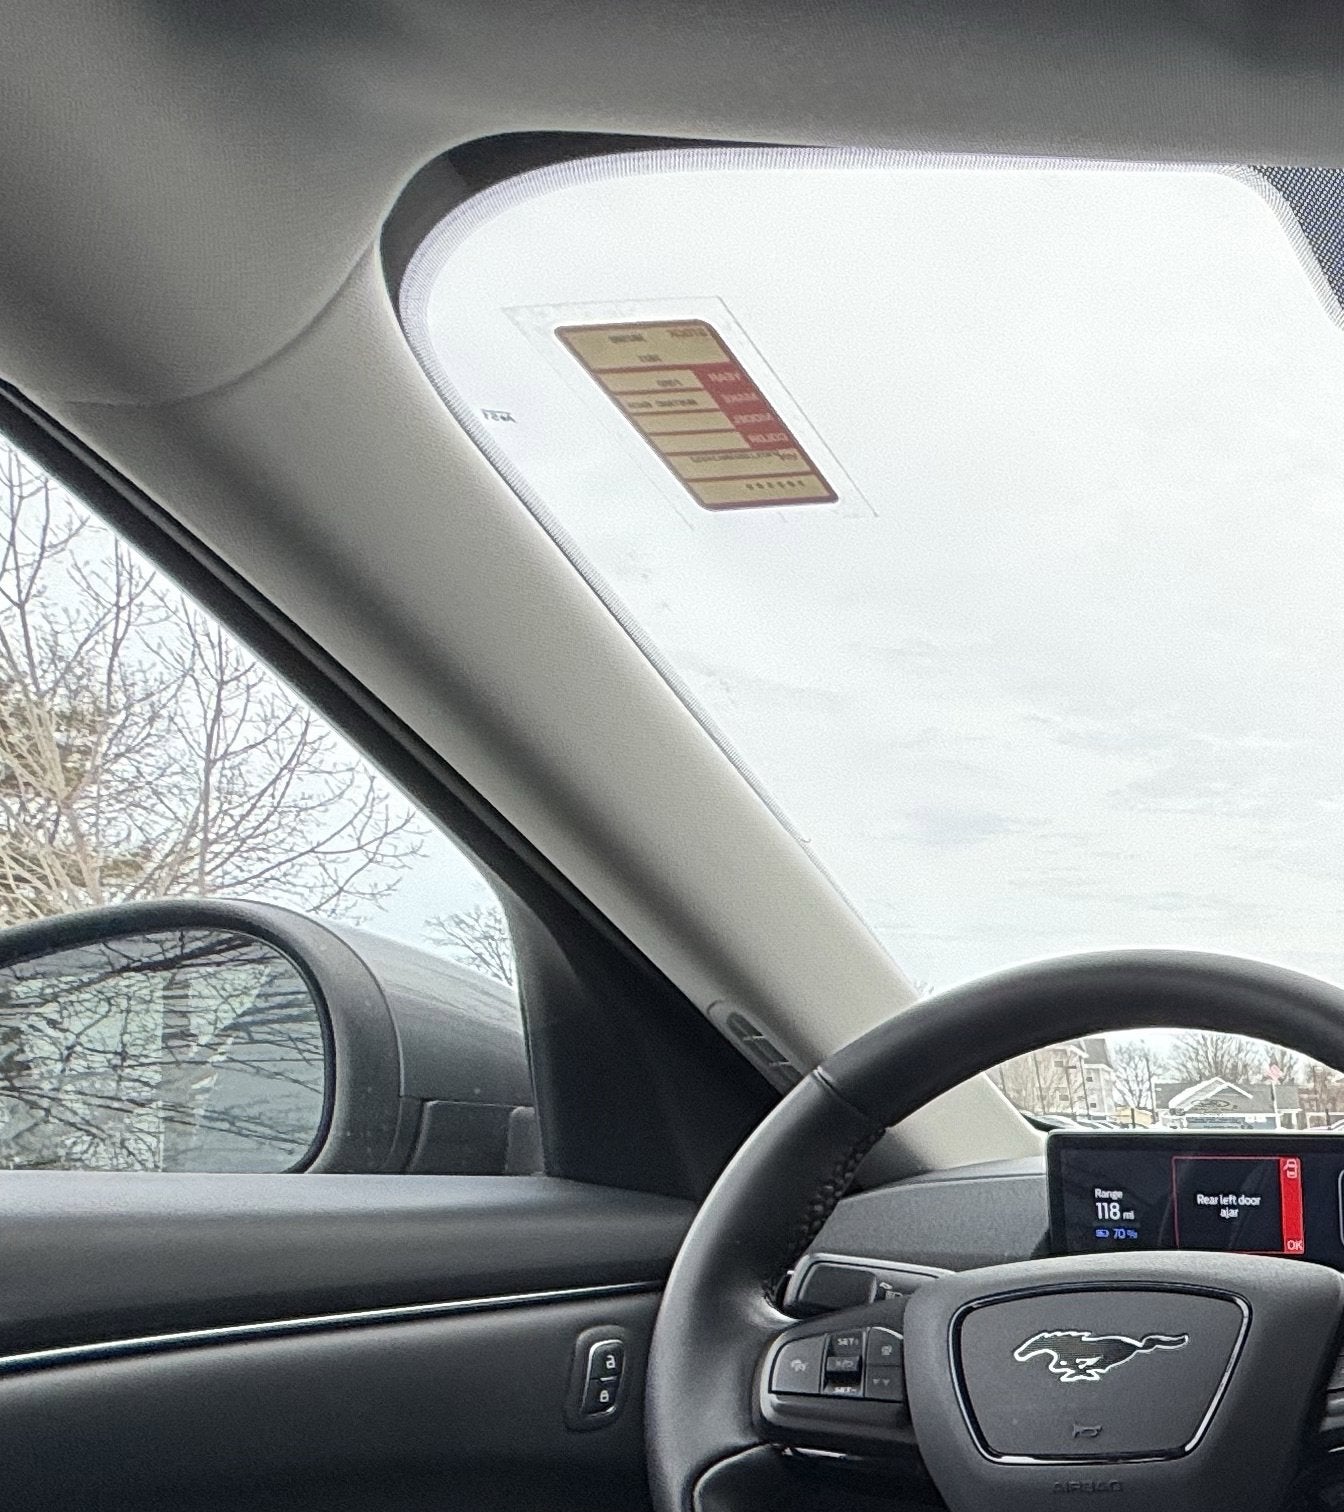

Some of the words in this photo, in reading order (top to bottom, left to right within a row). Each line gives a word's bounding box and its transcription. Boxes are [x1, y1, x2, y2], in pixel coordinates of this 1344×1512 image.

[1094, 1188, 1123, 1200] Range
[1196, 1194, 1219, 1205] Rear
[1219, 1194, 1237, 1205] left
[1238, 1194, 1261, 1206] door
[1096, 1202, 1121, 1220] 118
[1123, 1210, 1135, 1220] mi
[1220, 1207, 1239, 1219] ajar
[1287, 1239, 1303, 1250] OK
